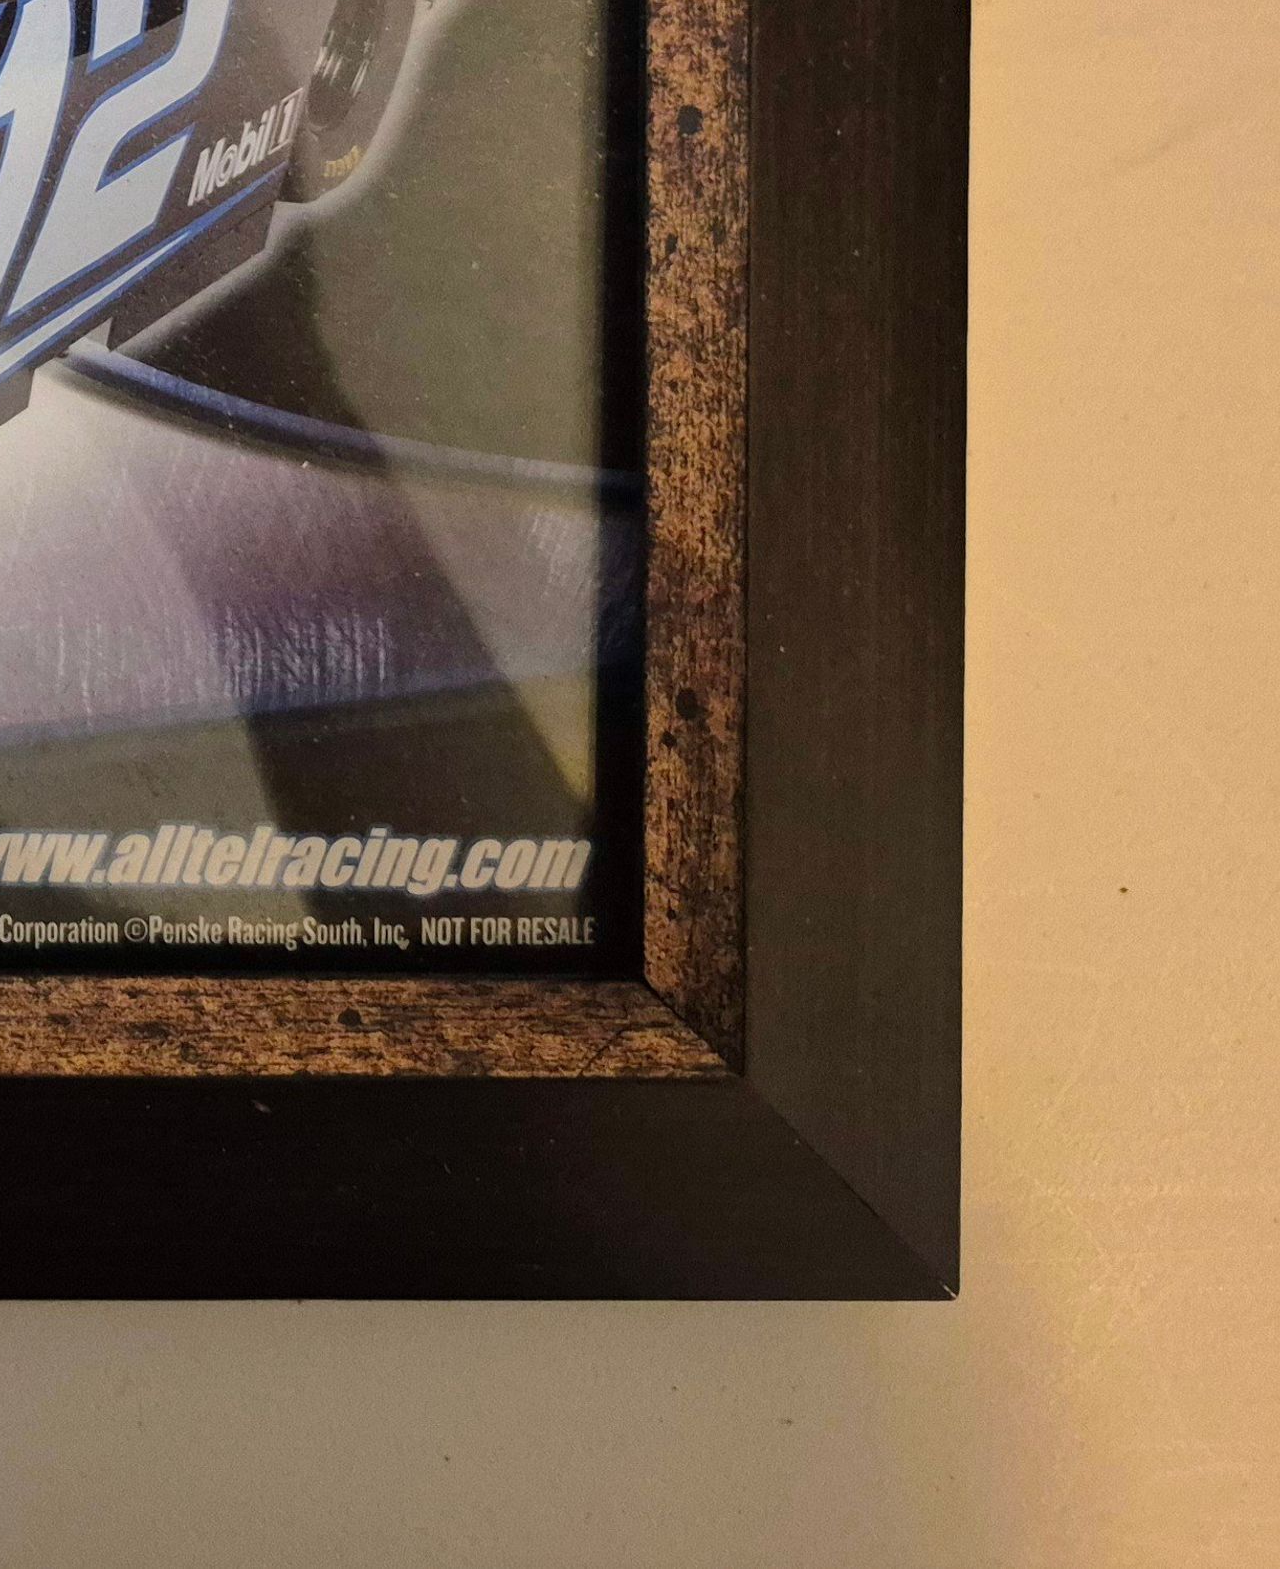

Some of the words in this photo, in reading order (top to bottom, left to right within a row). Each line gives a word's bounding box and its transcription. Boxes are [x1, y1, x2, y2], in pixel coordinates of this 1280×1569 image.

[187, 113, 278, 207] Mobil
[228, 915, 298, 952] Racing
[302, 916, 368, 948] South,
[421, 917, 466, 945] NOT
[470, 917, 513, 945] FOR
[516, 917, 596, 945] RESALE
